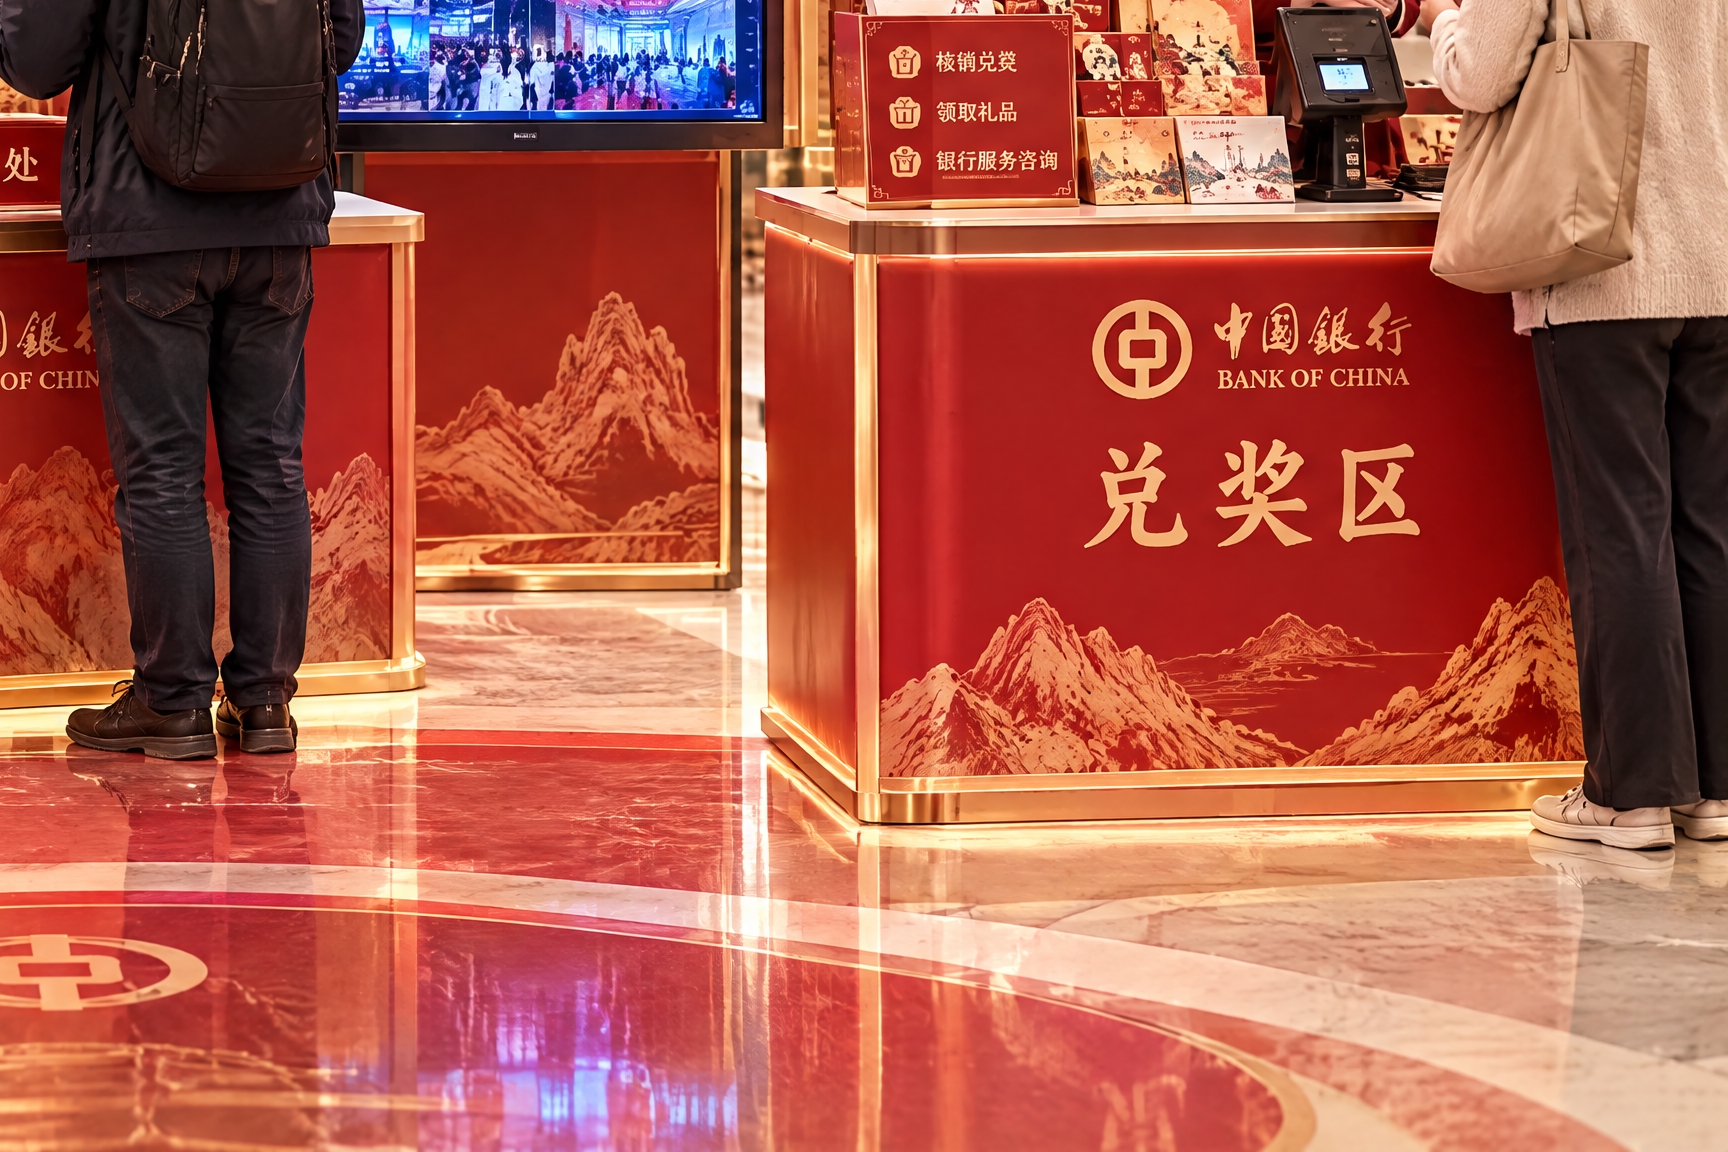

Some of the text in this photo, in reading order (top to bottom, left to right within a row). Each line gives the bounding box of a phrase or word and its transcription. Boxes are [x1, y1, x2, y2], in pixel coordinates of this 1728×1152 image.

[936, 101, 1017, 123] 领取礼品
[935, 149, 1058, 172] 银行服务咨询
[1, 372, 32, 390] OF
[39, 370, 99, 389] CHIN
[1218, 368, 1409, 389] BANK OF CHINA
[1084, 439, 1420, 548] 兑奖区
